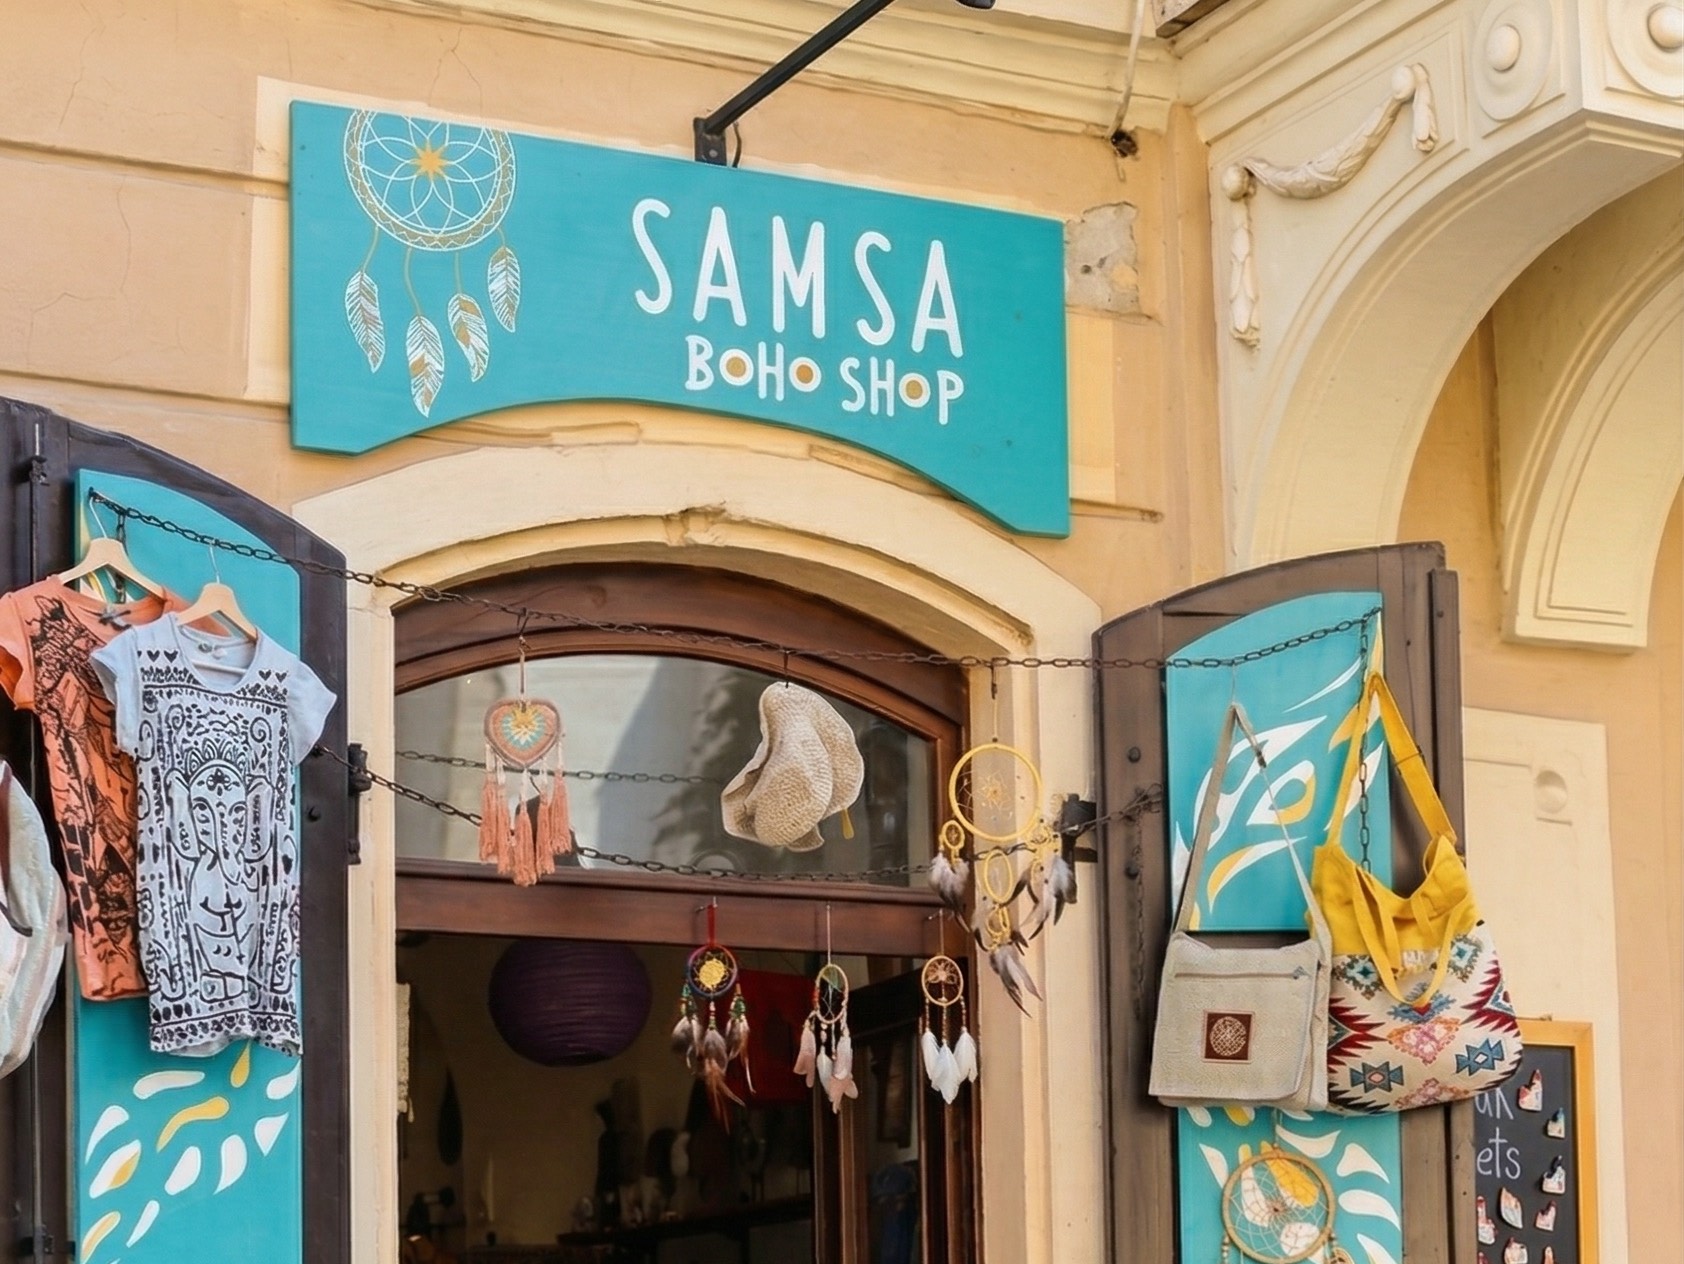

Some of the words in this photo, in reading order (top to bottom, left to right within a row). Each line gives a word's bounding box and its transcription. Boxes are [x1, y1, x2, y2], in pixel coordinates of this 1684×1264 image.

[632, 197, 963, 358] SAMSA
[685, 334, 822, 402] BOHO
[840, 356, 965, 426] SHOP
